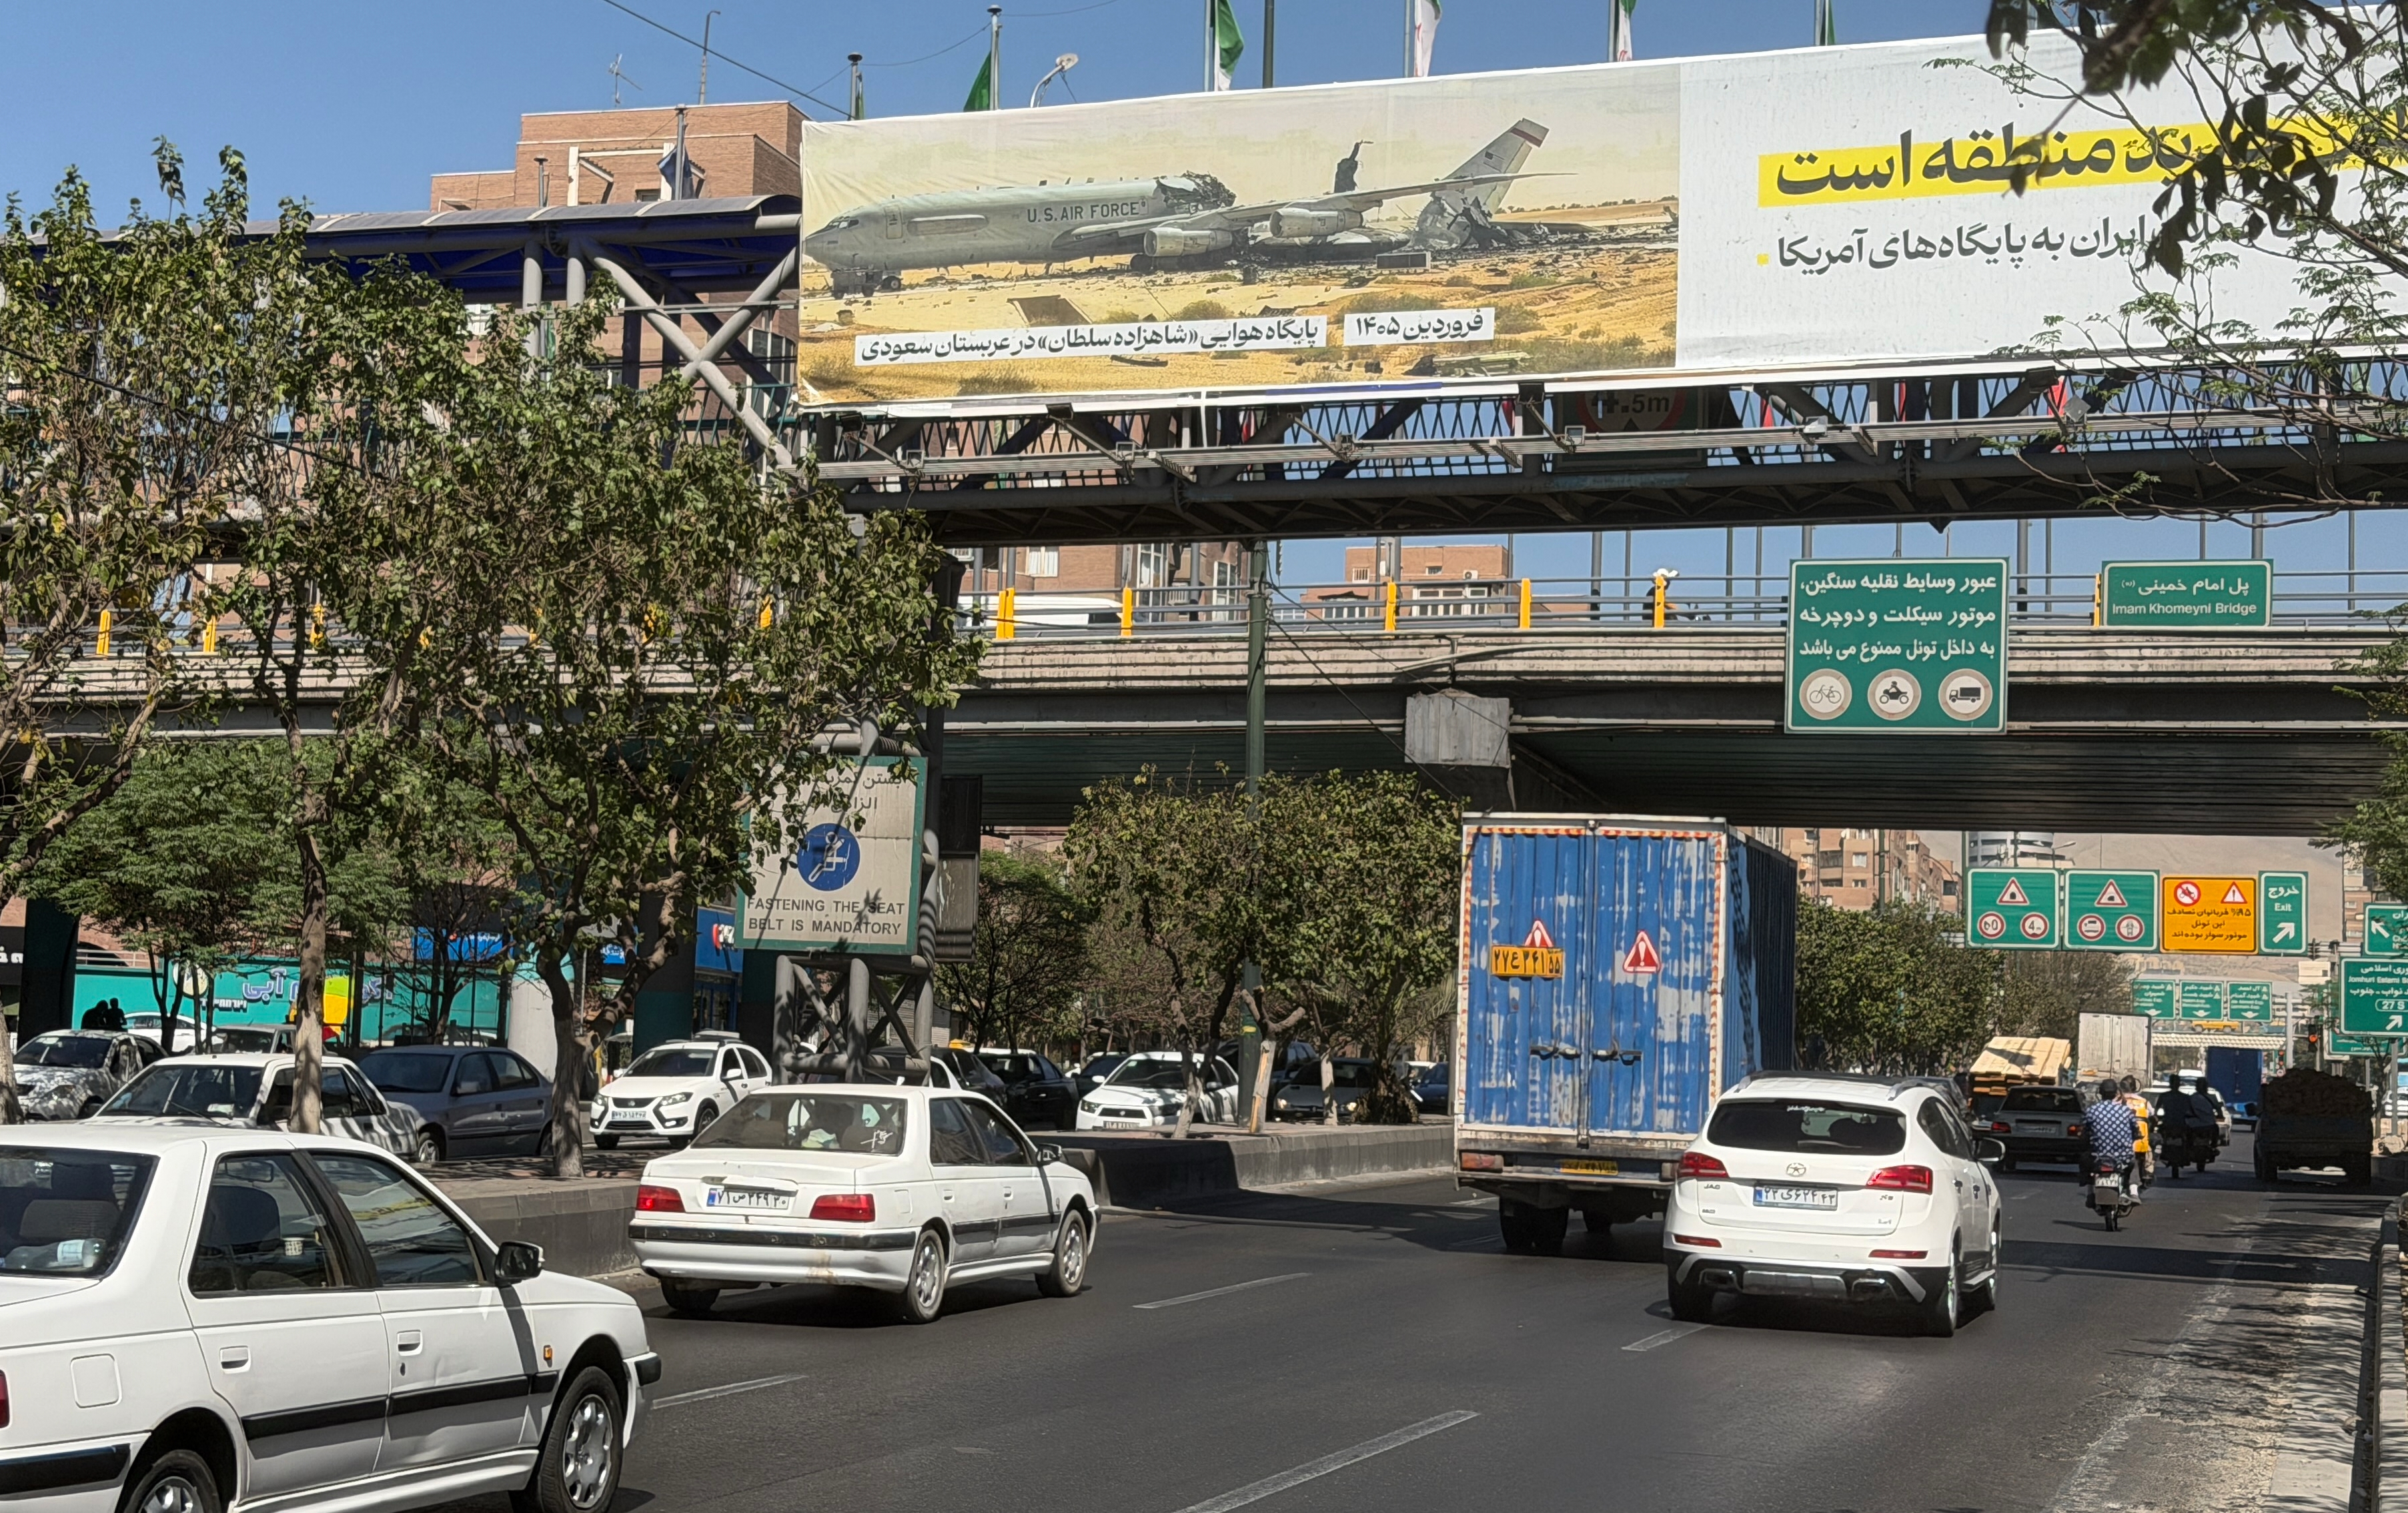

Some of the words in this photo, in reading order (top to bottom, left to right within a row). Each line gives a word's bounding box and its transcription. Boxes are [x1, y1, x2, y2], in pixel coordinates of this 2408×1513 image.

[1776, 129, 1912, 195] است
[1922, 121, 2117, 184] منطقه
[1061, 205, 1083, 221] AIR
[1091, 201, 1140, 218] FORCE
[1778, 227, 1868, 276] آمریکا
[2031, 225, 2064, 262] به
[1266, 318, 1318, 348] پایگاه
[1356, 316, 1400, 337] ۱۴۰۵
[1403, 308, 1483, 341] فروردین
[935, 333, 1011, 358] عربستان
[1010, 335, 1035, 356] در
[1200, 322, 1263, 349] هوایی
[861, 340, 932, 362] سعودی
[1860, 573, 1898, 593] نقلیه
[1903, 572, 1955, 594] وسایط
[1960, 576, 1996, 594] عبور
[2139, 579, 2187, 595] خمینی
[2193, 578, 2224, 595] امام
[2229, 578, 2249, 596] پل
[1800, 606, 1864, 628] دوچرخه
[1884, 606, 1942, 626] سیکلت
[1948, 608, 1995, 628] موتور
[2113, 604, 2146, 614] Imam
[2150, 602, 2211, 615] Khomeyni
[2216, 602, 2257, 616] Bridge
[1868, 613, 1878, 628] و
[1800, 638, 1832, 660] باشد
[1836, 646, 1856, 660] می
[1860, 641, 1901, 662] ممنوع
[1906, 638, 1936, 661] تونل
[1940, 638, 1974, 660] داخل
[1980, 641, 1994, 658] به
[2268, 886, 2299, 899] خروج
[748, 898, 825, 911] FASTENING
[833, 901, 860, 913] THE
[867, 902, 905, 915] SEAT
[2275, 903, 2292, 912] Exit
[748, 918, 784, 930] BELT
[792, 919, 804, 931] IS
[812, 921, 902, 935] MANDATORY
[2361, 965, 2392, 973] اسلامی
[2382, 1001, 2395, 1009] 27
